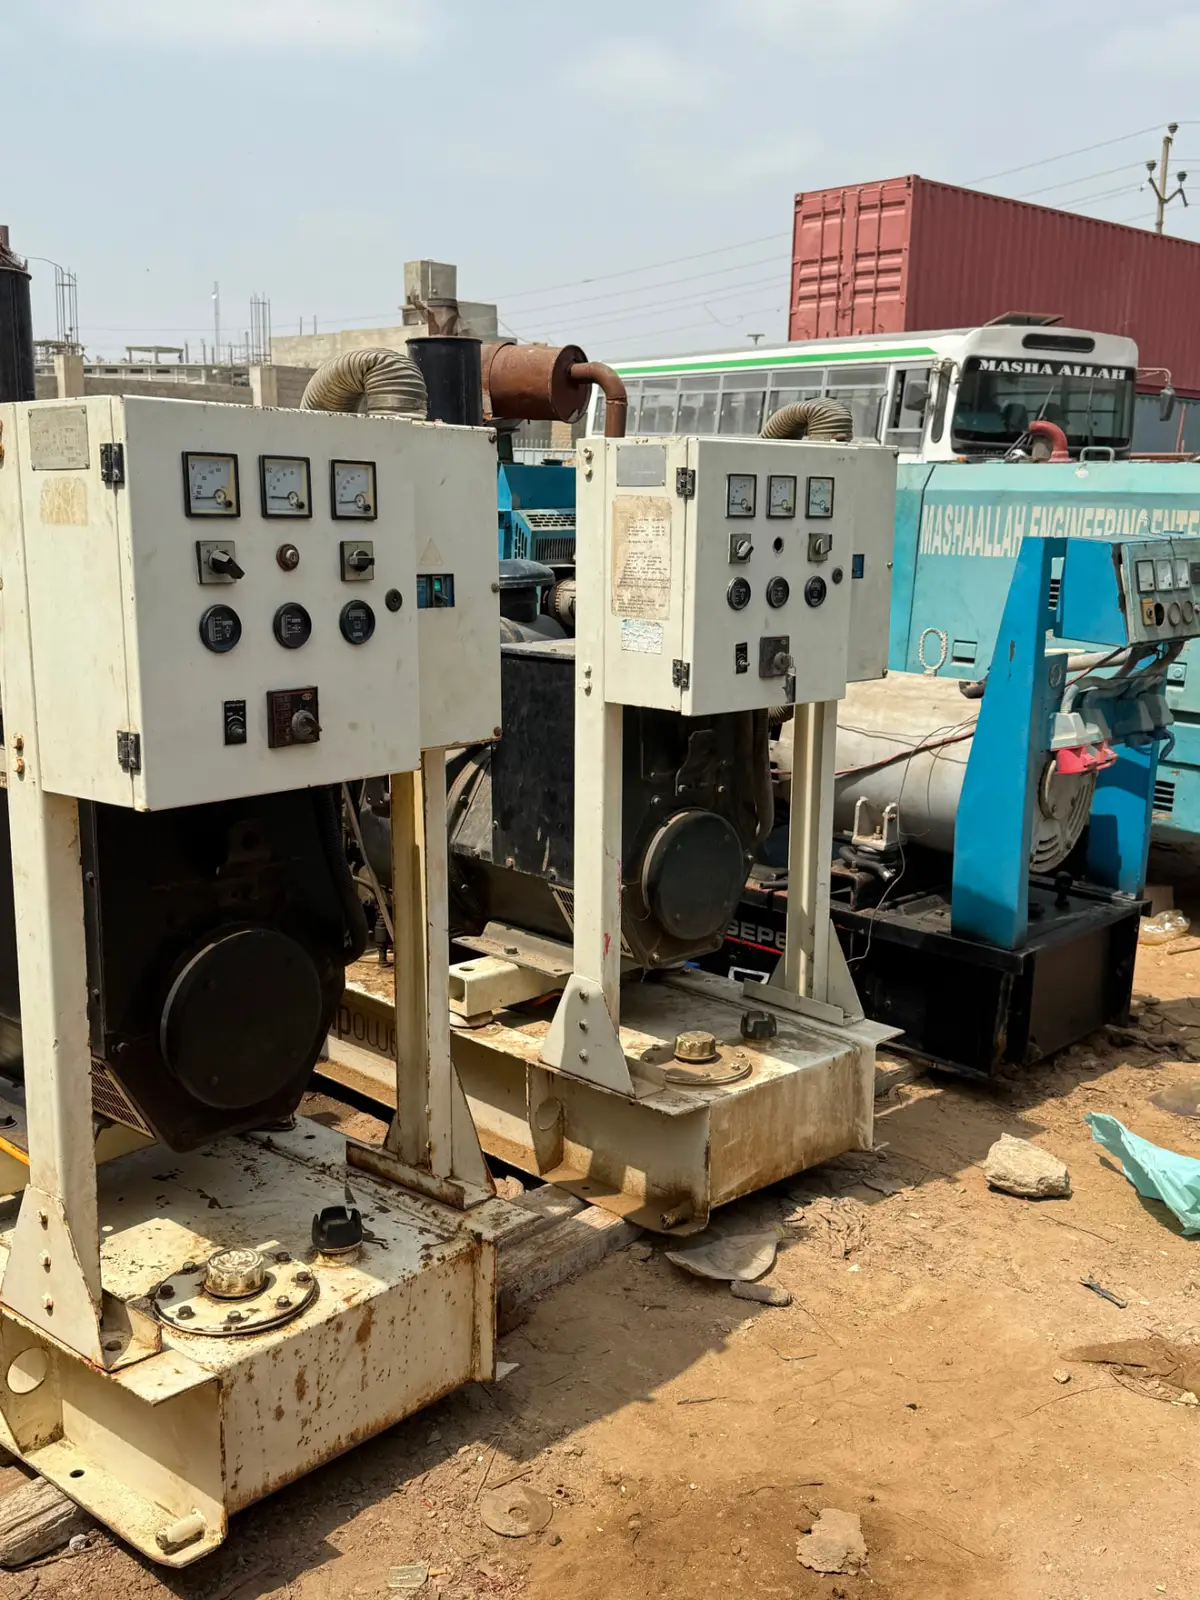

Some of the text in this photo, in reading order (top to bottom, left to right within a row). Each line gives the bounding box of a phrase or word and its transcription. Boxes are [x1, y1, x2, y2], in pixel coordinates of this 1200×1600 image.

[978, 359, 1126, 380] MASHA ALLAH
[920, 504, 1027, 557] MASHAALLAH
[1151, 508, 1200, 536] ENTE
